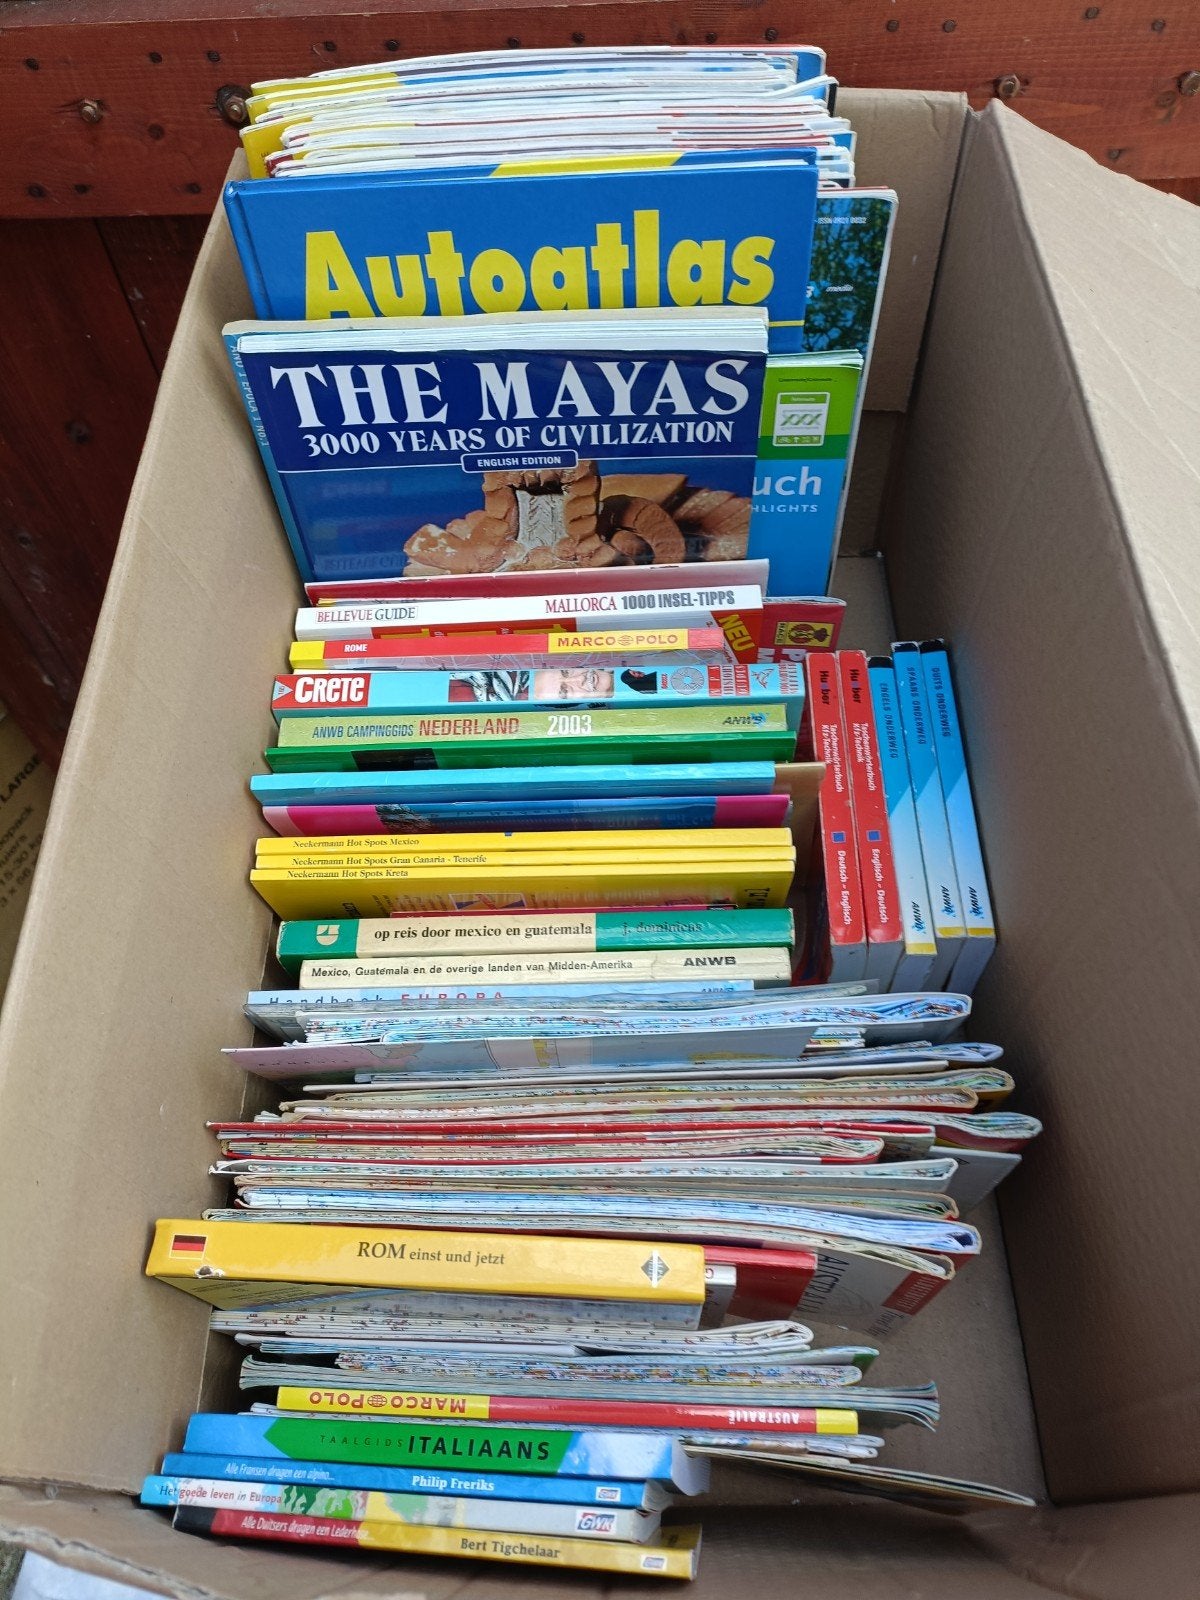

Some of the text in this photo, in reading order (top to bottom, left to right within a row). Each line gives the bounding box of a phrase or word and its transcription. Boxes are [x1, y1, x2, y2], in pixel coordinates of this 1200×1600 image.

[305, 209, 776, 320] Autoatlas
[270, 359, 751, 429] THE MAYAS
[302, 420, 735, 457] 3000 YEARS OF CIVILIZATION
[477, 455, 562, 468] ENGLISH EDITION
[545, 590, 735, 613] MALLORCA 1000 INSEL-TIPPS
[317, 606, 416, 623] BELLEVUE GUIDE
[557, 634, 678, 647] MARCO POLO
[718, 614, 756, 652] NEU
[344, 643, 368, 653] ROME
[906, 667, 927, 745] SPAANS ONDERWEG
[931, 667, 951, 738] DUITS ONDERWEG
[312, 714, 592, 738] ANWB CAMPINGGIDS NEDERLAND 2003
[880, 682, 899, 759] ENGELS ONDERWEG
[293, 838, 420, 848] Neckermann Hot Spots Mexico
[292, 857, 343, 866] Neckermann
[346, 857, 361, 865] Hot
[363, 857, 387, 866] Spots
[389, 856, 410, 865] Gran
[413, 855, 445, 864] Canaria
[453, 854, 487, 863] Tenerife
[837, 850, 849, 883] Deutsch
[871, 848, 885, 882] Englisch
[287, 869, 409, 879] Neckermann Hot Spots Kreta
[839, 889, 853, 925] Englisch
[876, 889, 890, 924] Deutsch
[374, 929, 390, 941] op
[394, 926, 417, 939] reis
[421, 926, 450, 938] door
[455, 926, 502, 938] mexico
[505, 927, 521, 936] en
[524, 923, 593, 939] guatemala
[311, 956, 737, 977] Mexico, Guatemala en de overige landen van Midden-Amerika ANWB
[357, 1241, 505, 1267] ROM einst und jetzt
[309, 1391, 466, 1414] MARCO POLO
[729, 1409, 799, 1425] AUSTRALIË
[320, 1434, 550, 1461] TAALGIDS ITALIAANS
[225, 1462, 237, 1473] Alle
[239, 1464, 267, 1476] Fransen
[268, 1466, 292, 1480] dragen
[293, 1469, 307, 1478] een
[412, 1475, 448, 1489] Philip
[451, 1478, 495, 1491] Freriks
[159, 1485, 282, 1505] Het goede leven in Europa
[579, 1513, 614, 1532] GWK
[241, 1516, 256, 1528] Alle
[256, 1517, 288, 1532] Duitsers
[288, 1520, 315, 1536] dragen
[316, 1525, 330, 1535] een
[460, 1538, 487, 1552] Bert
[492, 1540, 560, 1559] Tigchelaar
